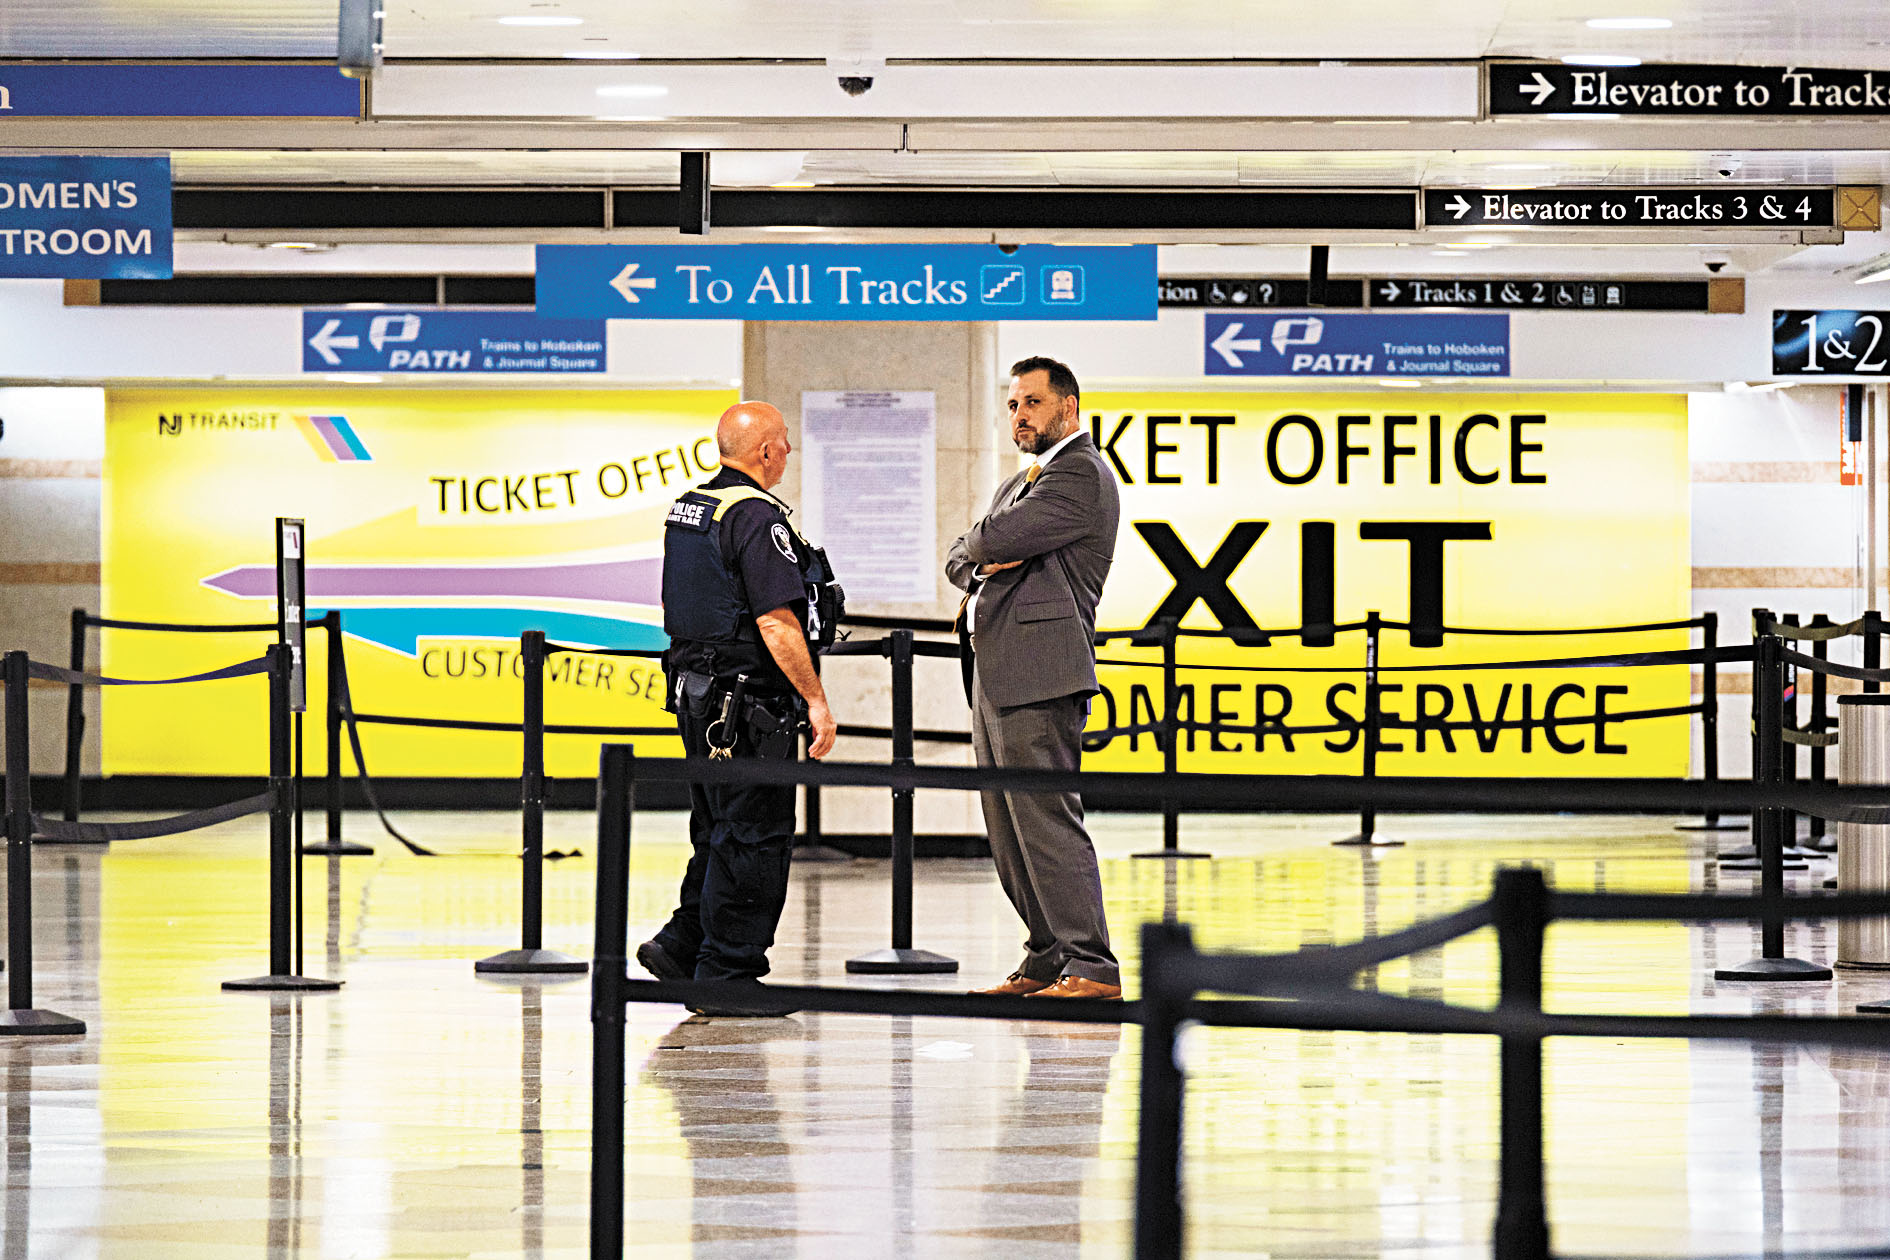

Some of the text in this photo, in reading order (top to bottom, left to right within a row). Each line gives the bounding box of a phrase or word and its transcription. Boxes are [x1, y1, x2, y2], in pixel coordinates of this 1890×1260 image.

[1571, 71, 1890, 107] Elevator to Track
[1482, 194, 1812, 221] Elevator to Tracks 3 & 4
[675, 264, 968, 305] To All Tracks
[1408, 281, 1546, 304] Tracks 1 & 2
[388, 349, 471, 369] PATH
[1383, 343, 1505, 355] Trains to Hoboken
[1291, 354, 1374, 372] PATH
[1387, 360, 1501, 374] & Journal Square
[189, 411, 279, 429] TRANSIT
[1266, 414, 1547, 485] OFFICE
[430, 470, 580, 513] TICKET
[1095, 522, 1492, 648] XIT
[1324, 682, 1629, 755] SERVICE
